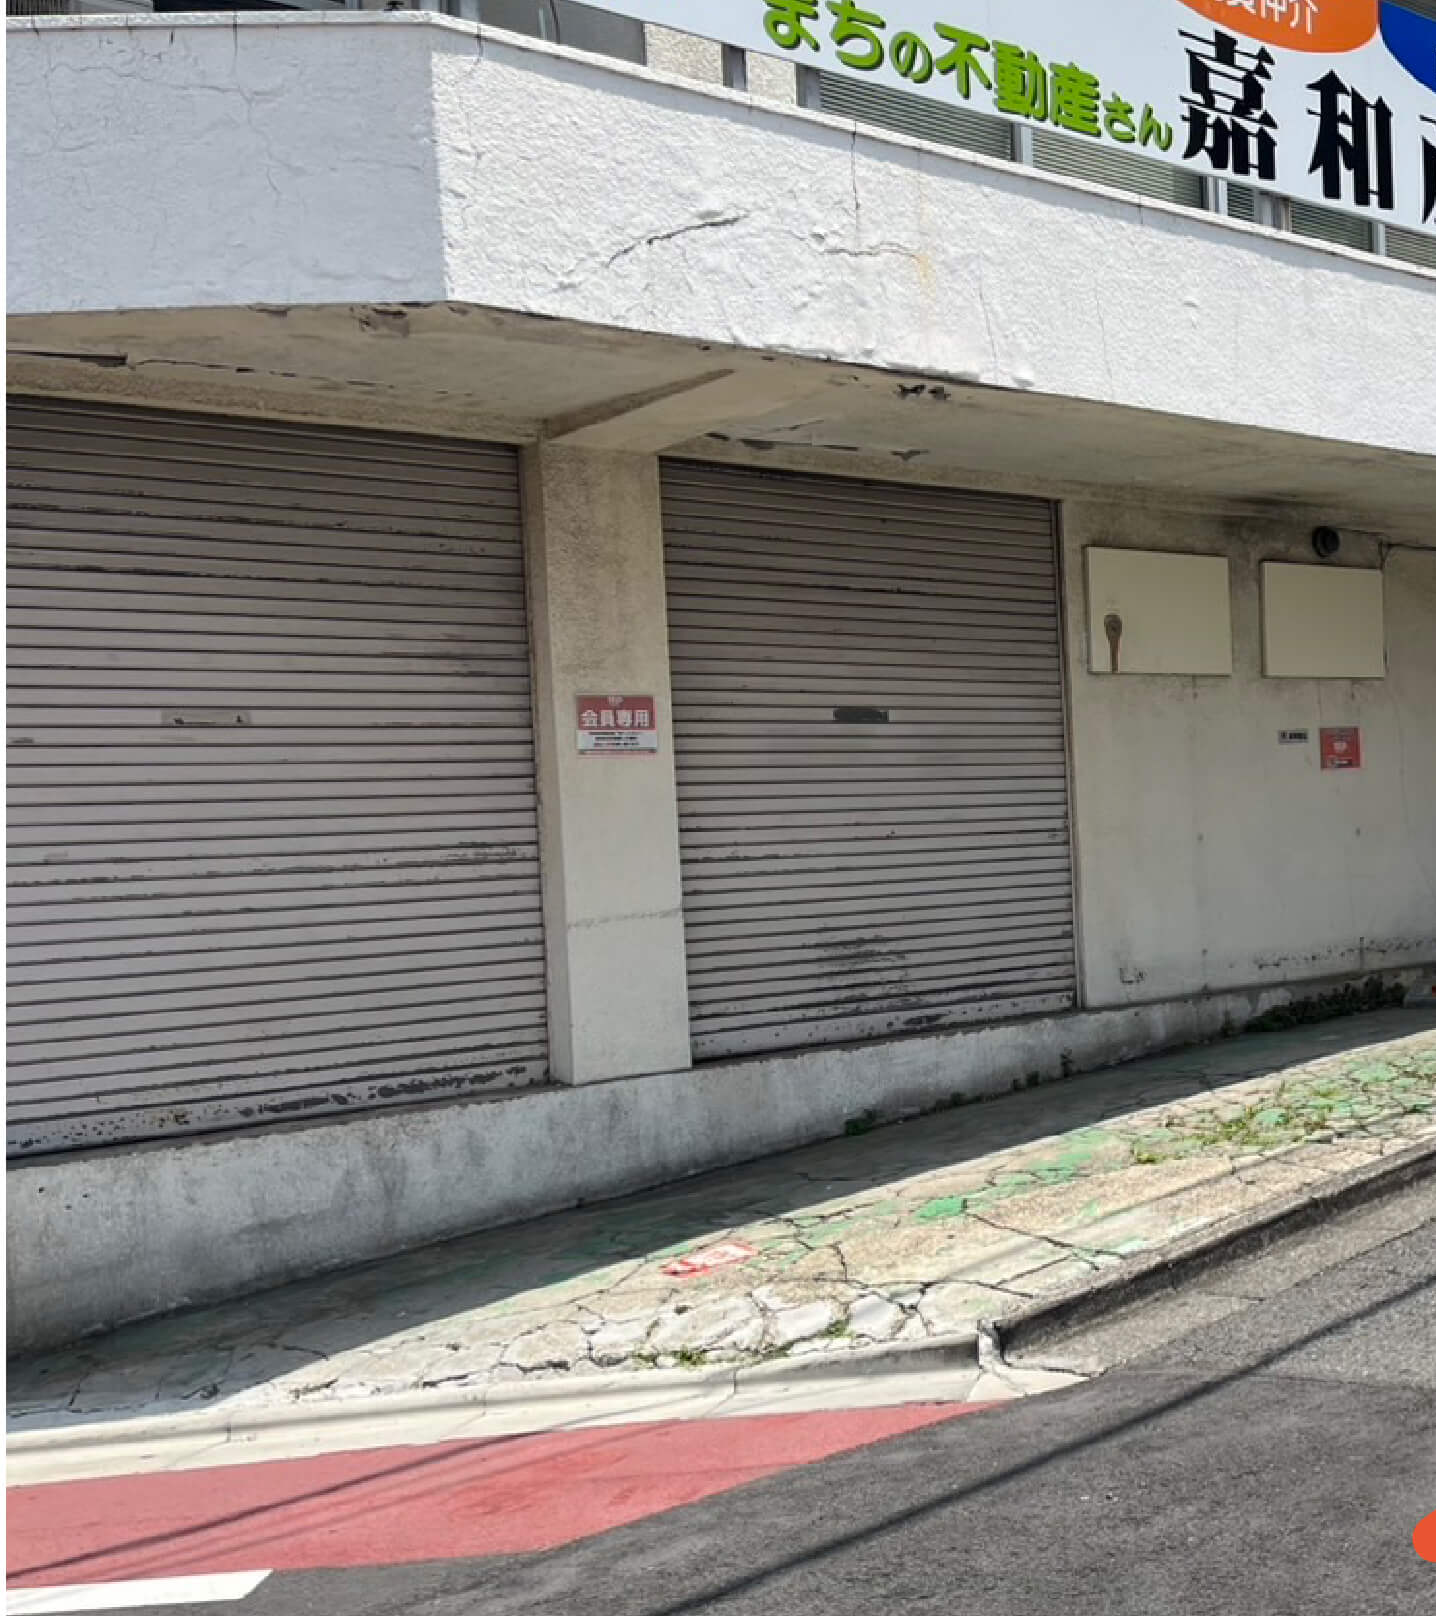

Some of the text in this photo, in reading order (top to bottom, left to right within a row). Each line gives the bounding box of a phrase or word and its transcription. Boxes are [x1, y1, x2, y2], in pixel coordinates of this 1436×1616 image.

[762, 0, 1173, 152] まちの不動産さん
[580, 709, 649, 728] 会員専用
